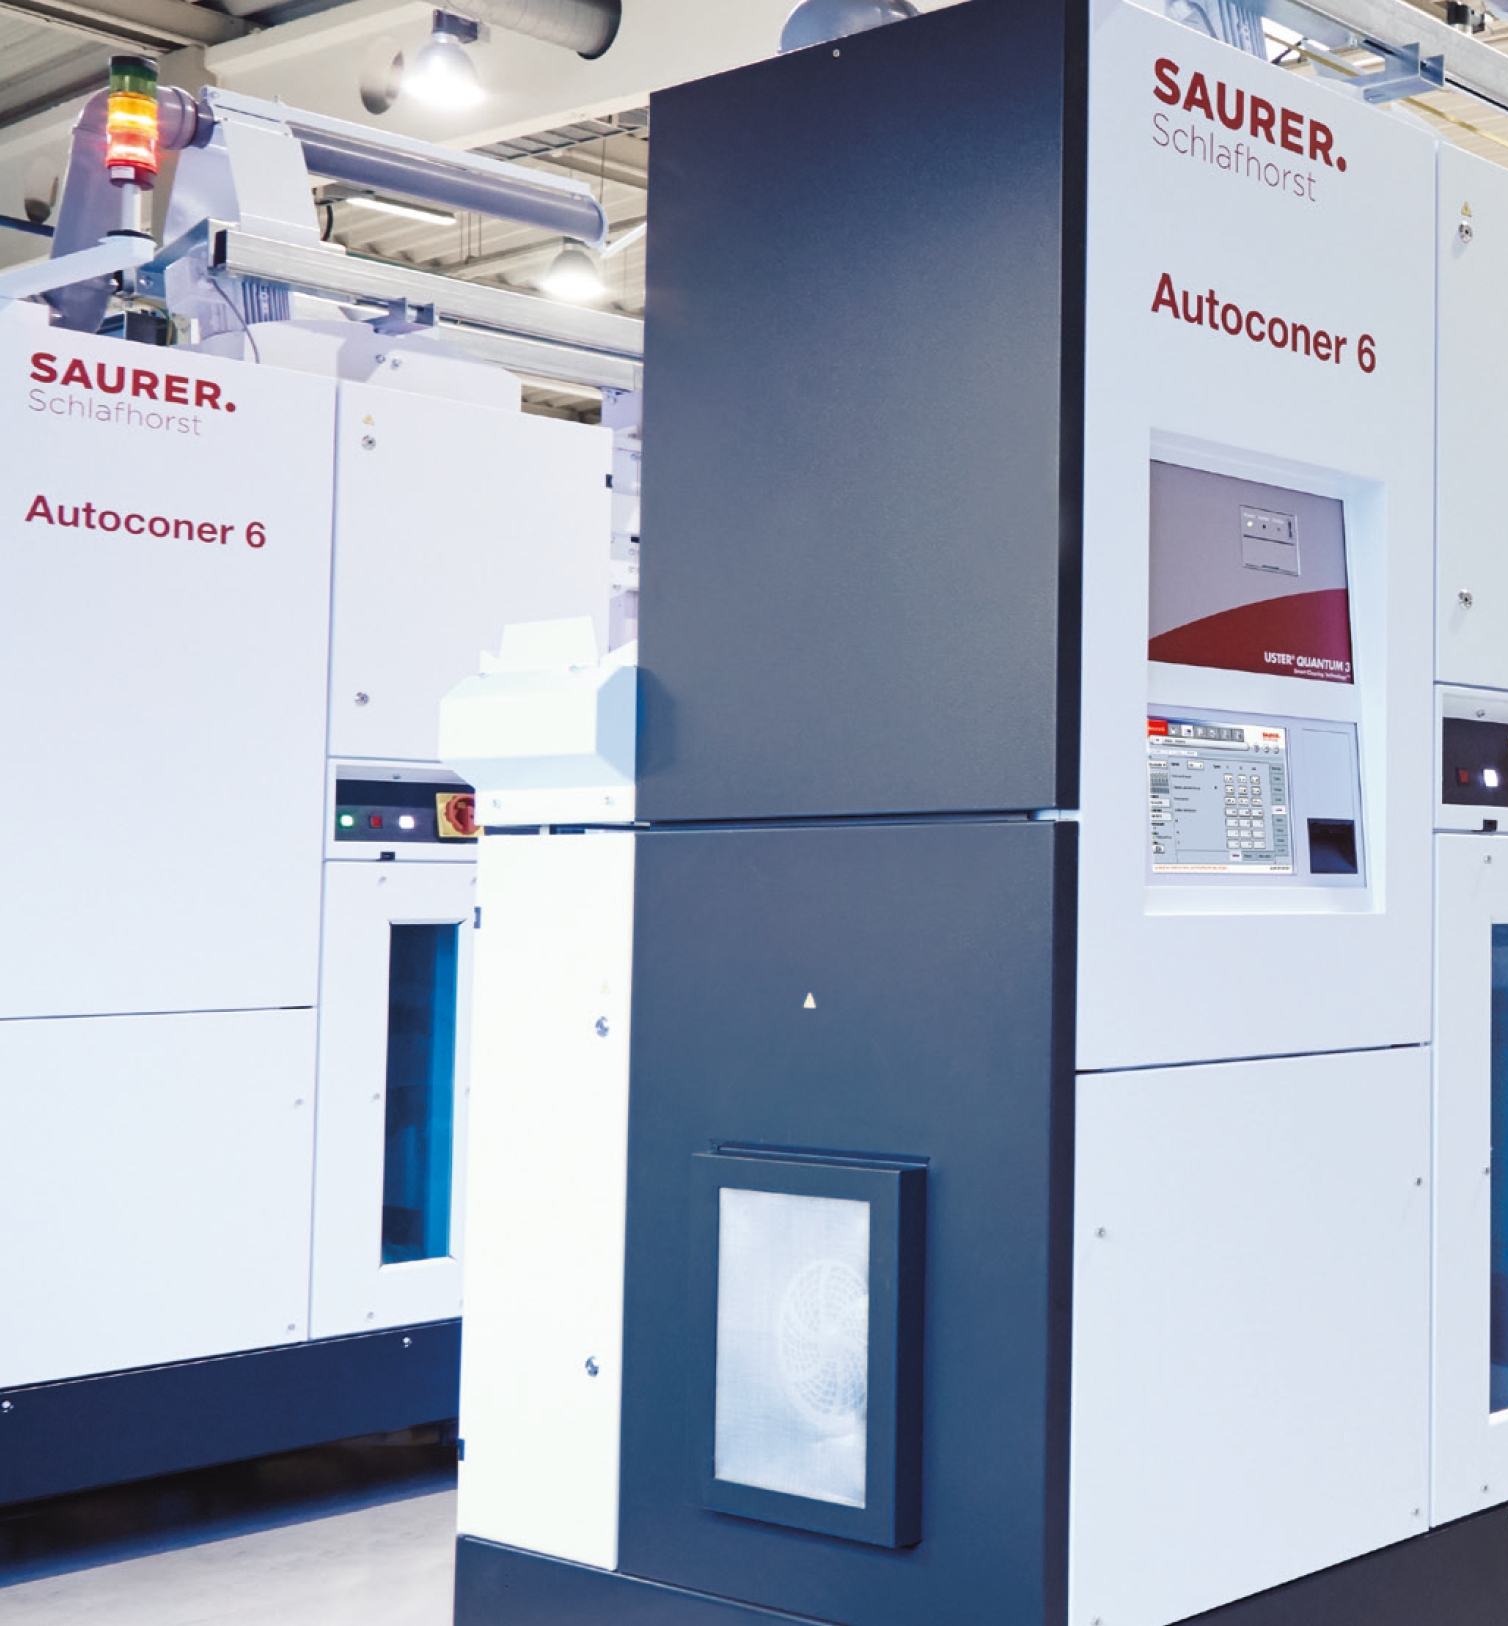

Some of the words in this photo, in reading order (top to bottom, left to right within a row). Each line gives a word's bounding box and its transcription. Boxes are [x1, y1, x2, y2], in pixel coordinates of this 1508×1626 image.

[1153, 57, 1348, 173] SAURER.
[1152, 112, 1316, 202] Schlafhorst
[1151, 272, 1348, 365] Autoconer
[1357, 333, 1377, 375] 6
[28, 388, 203, 437] Schlafhorst
[29, 352, 237, 414] SAURER.
[24, 494, 235, 546] Autoconer
[245, 521, 267, 550] 6
[1297, 656, 1343, 671] QUANTUM
[1345, 662, 1351, 672] 3
